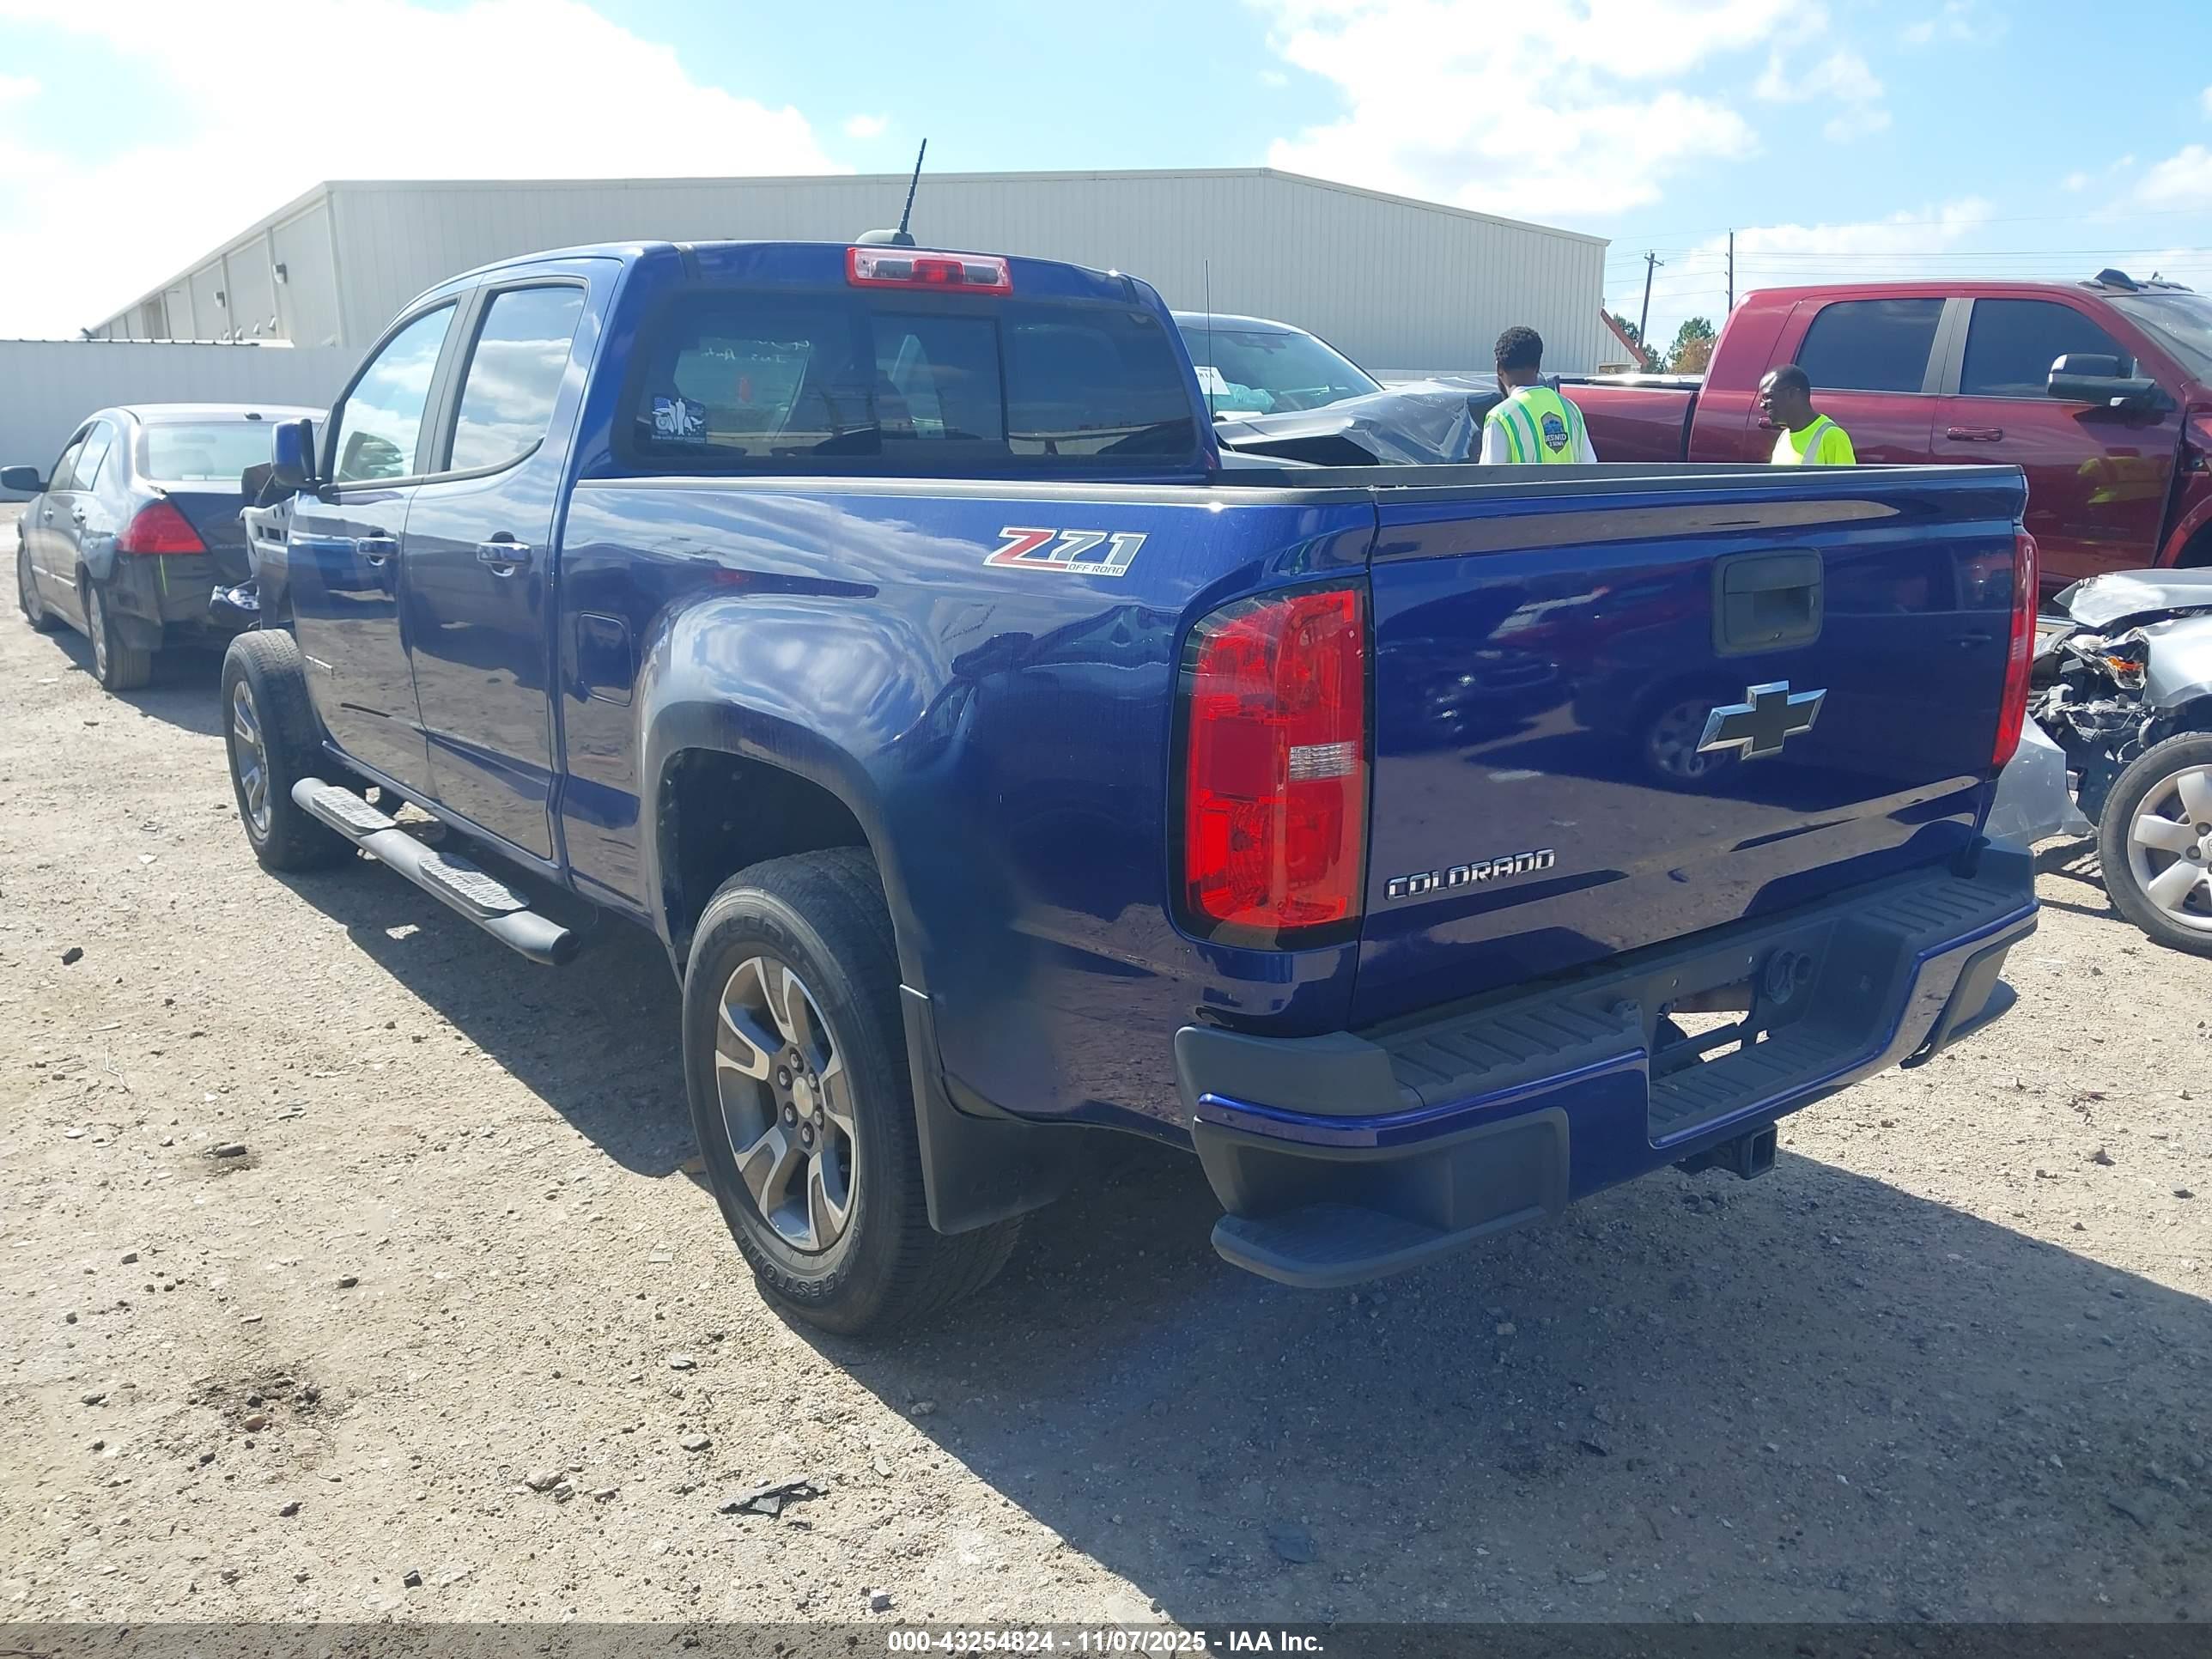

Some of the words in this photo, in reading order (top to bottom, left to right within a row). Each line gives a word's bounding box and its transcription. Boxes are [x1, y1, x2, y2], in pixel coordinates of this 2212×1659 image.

[982, 526, 1148, 573] Z71
[1067, 562, 1091, 573] OFF
[1091, 564, 1124, 575] ROAD
[1385, 848, 1556, 901] COLORADO
